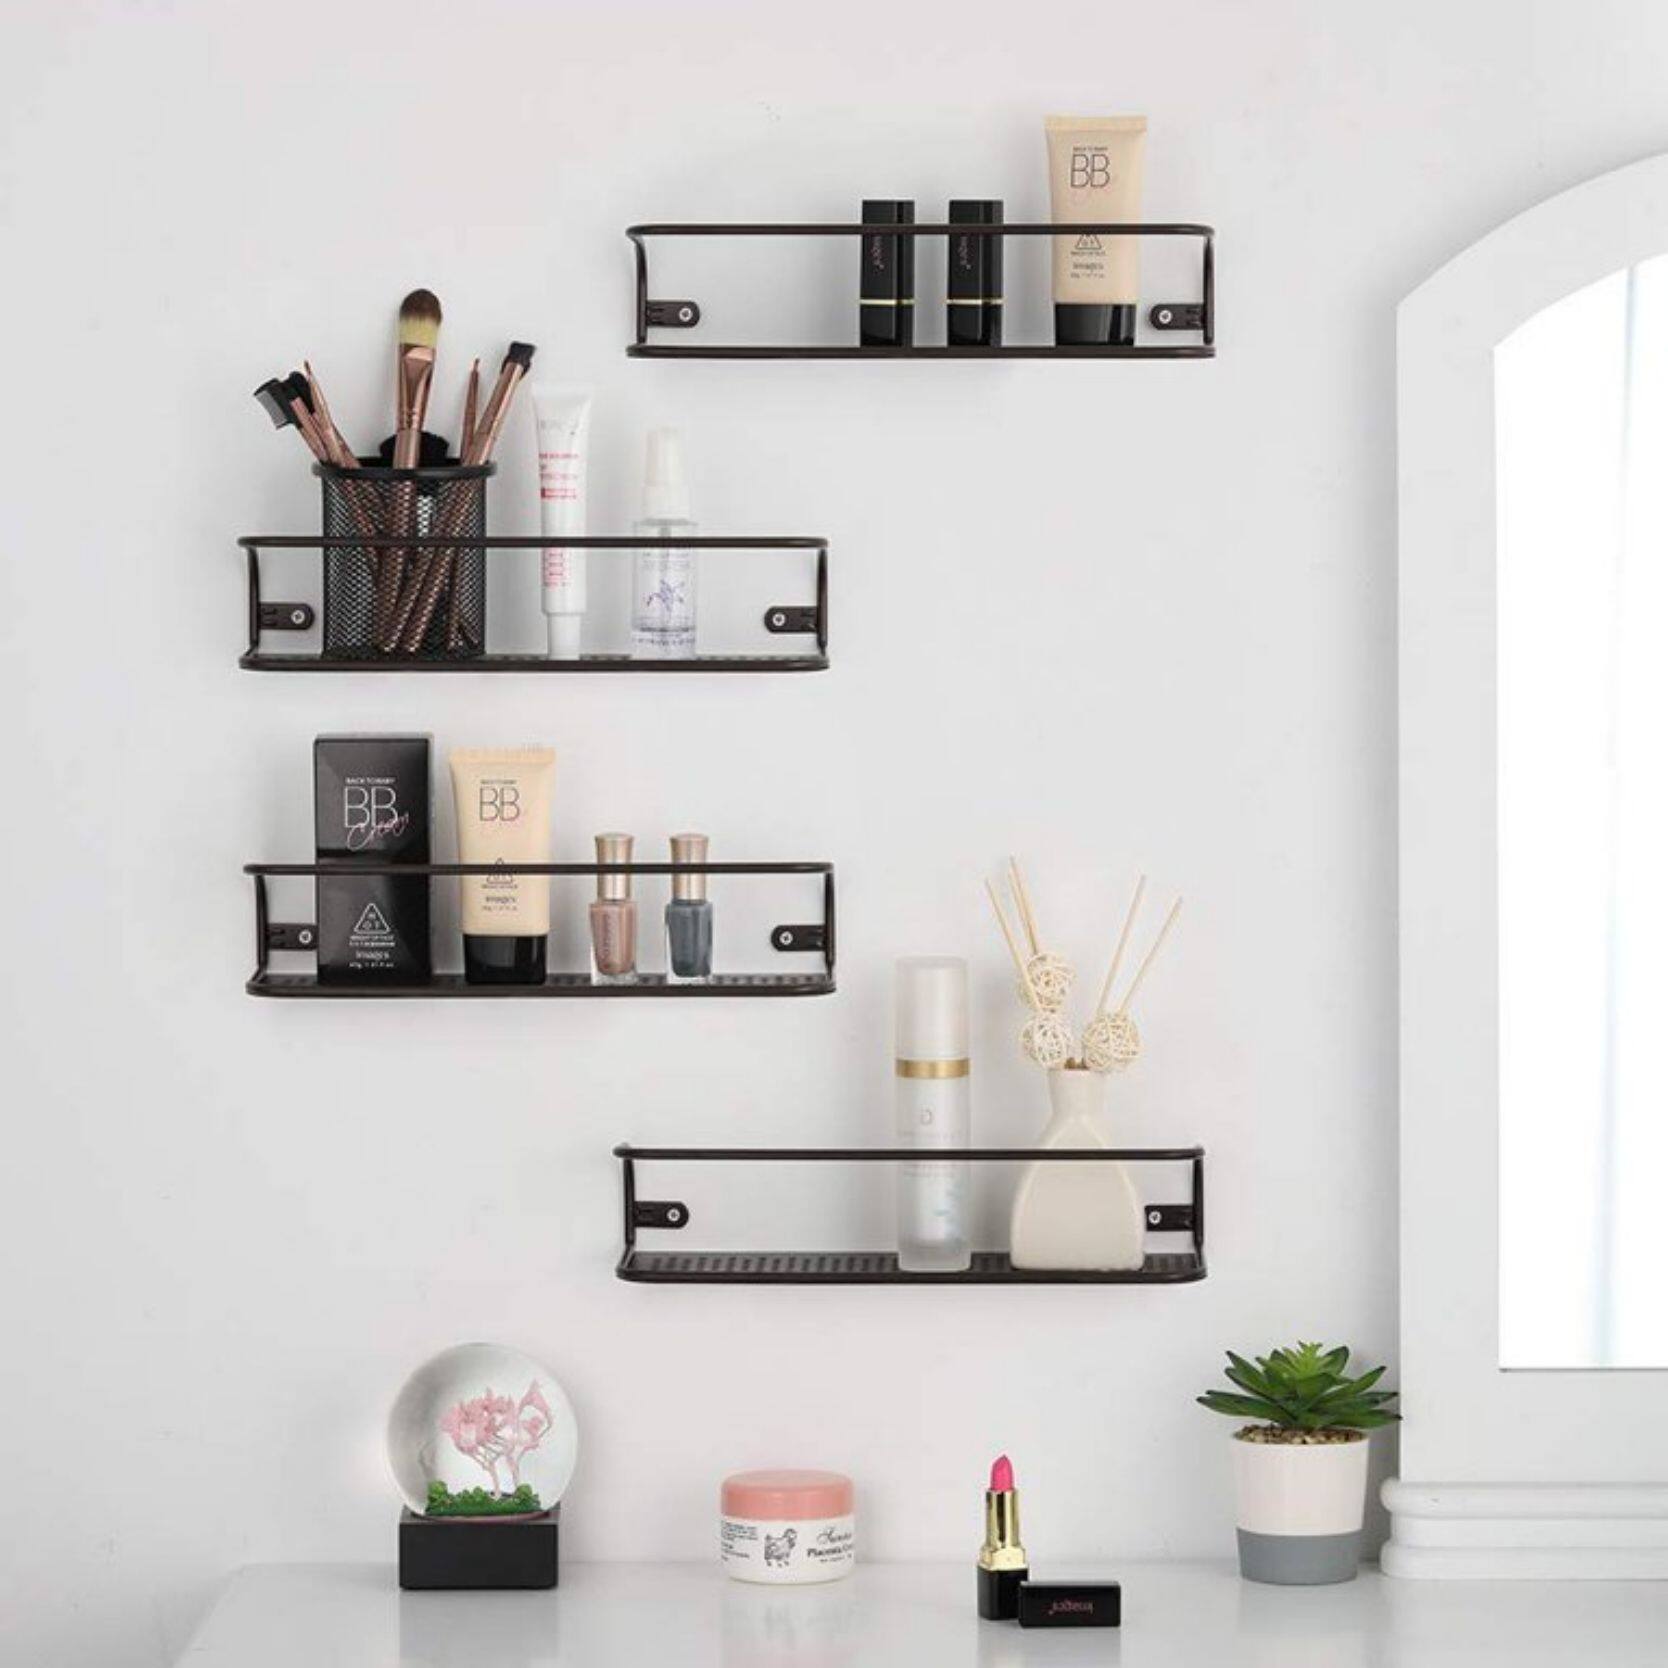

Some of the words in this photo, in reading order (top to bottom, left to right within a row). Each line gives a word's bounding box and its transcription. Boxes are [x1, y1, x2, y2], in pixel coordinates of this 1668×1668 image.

[1070, 154, 1110, 188] BB
[344, 786, 398, 828] BB
[480, 787, 520, 821] BB
